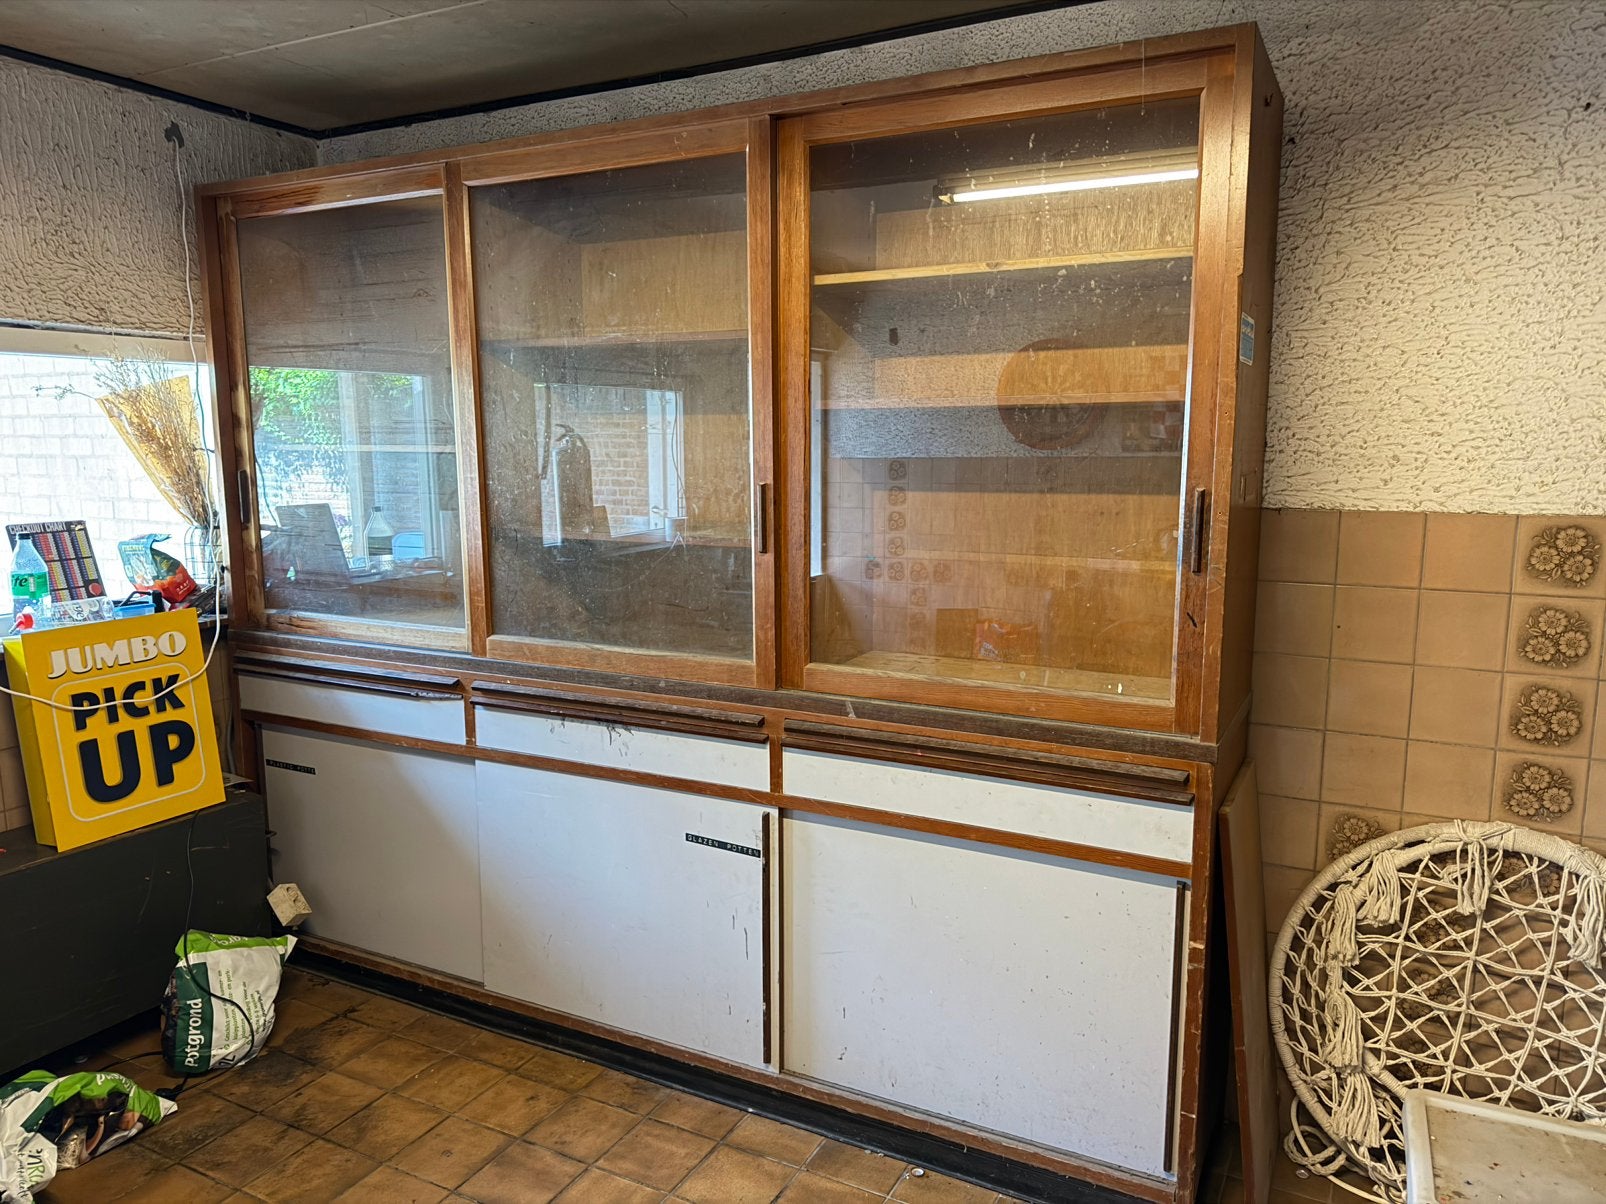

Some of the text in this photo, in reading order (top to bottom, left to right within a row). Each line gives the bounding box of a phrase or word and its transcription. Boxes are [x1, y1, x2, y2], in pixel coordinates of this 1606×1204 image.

[45, 521, 67, 532] CHART
[48, 631, 187, 678] JUMBO
[71, 674, 186, 732] PICK
[79, 720, 196, 804] UP
[687, 834, 760, 857] GLAZEN POTTEN
[184, 998, 205, 1067] Potgrond
